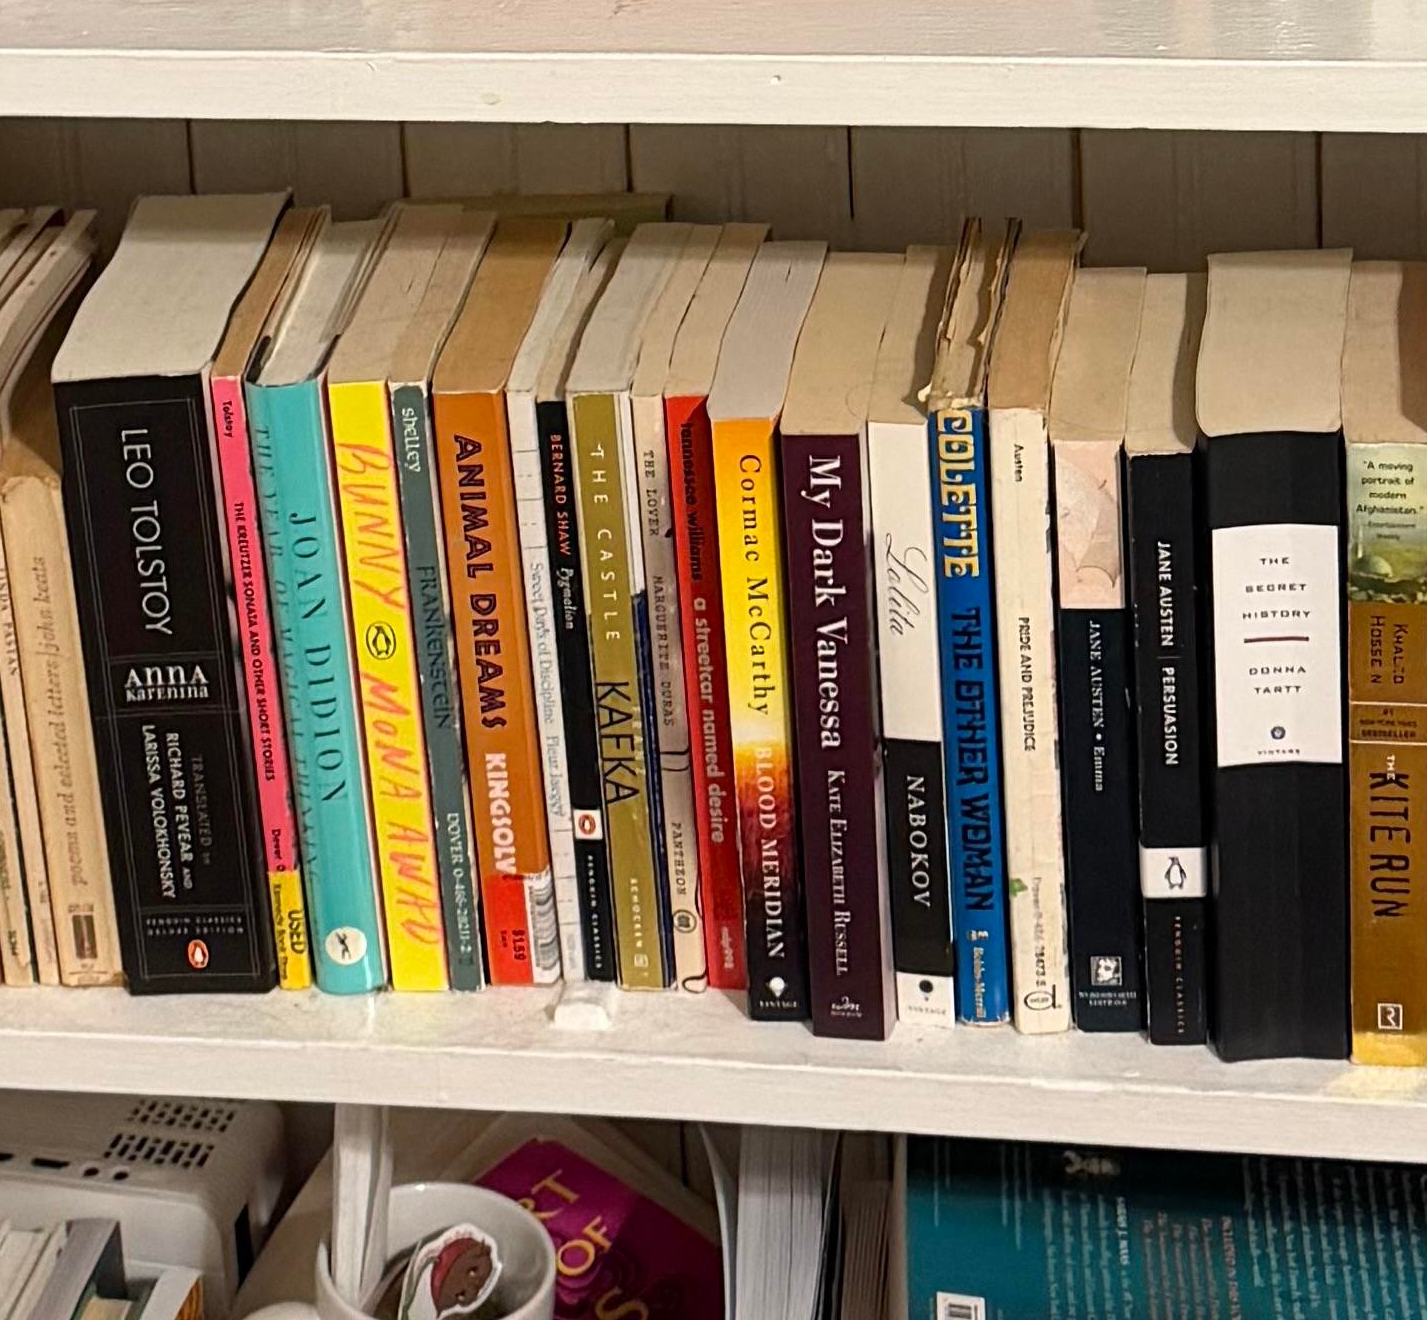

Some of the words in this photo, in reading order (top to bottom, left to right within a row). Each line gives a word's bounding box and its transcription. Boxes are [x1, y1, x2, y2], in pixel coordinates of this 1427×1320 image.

[454, 434, 496, 581] ANIMAL
[738, 454, 760, 563] Cormac
[801, 454, 841, 510] My
[289, 512, 326, 620] JOAN
[809, 518, 845, 608] Dark
[1242, 609, 1311, 620] HISTORY
[469, 593, 507, 731] DREAMS
[745, 572, 775, 717] McCarthy
[813, 618, 850, 750] Vanessa
[305, 643, 347, 803] DIDION
[596, 682, 639, 805] KAFKA
[761, 836, 786, 959] MERIDIAN
[906, 775, 931, 908] NABOKOV
